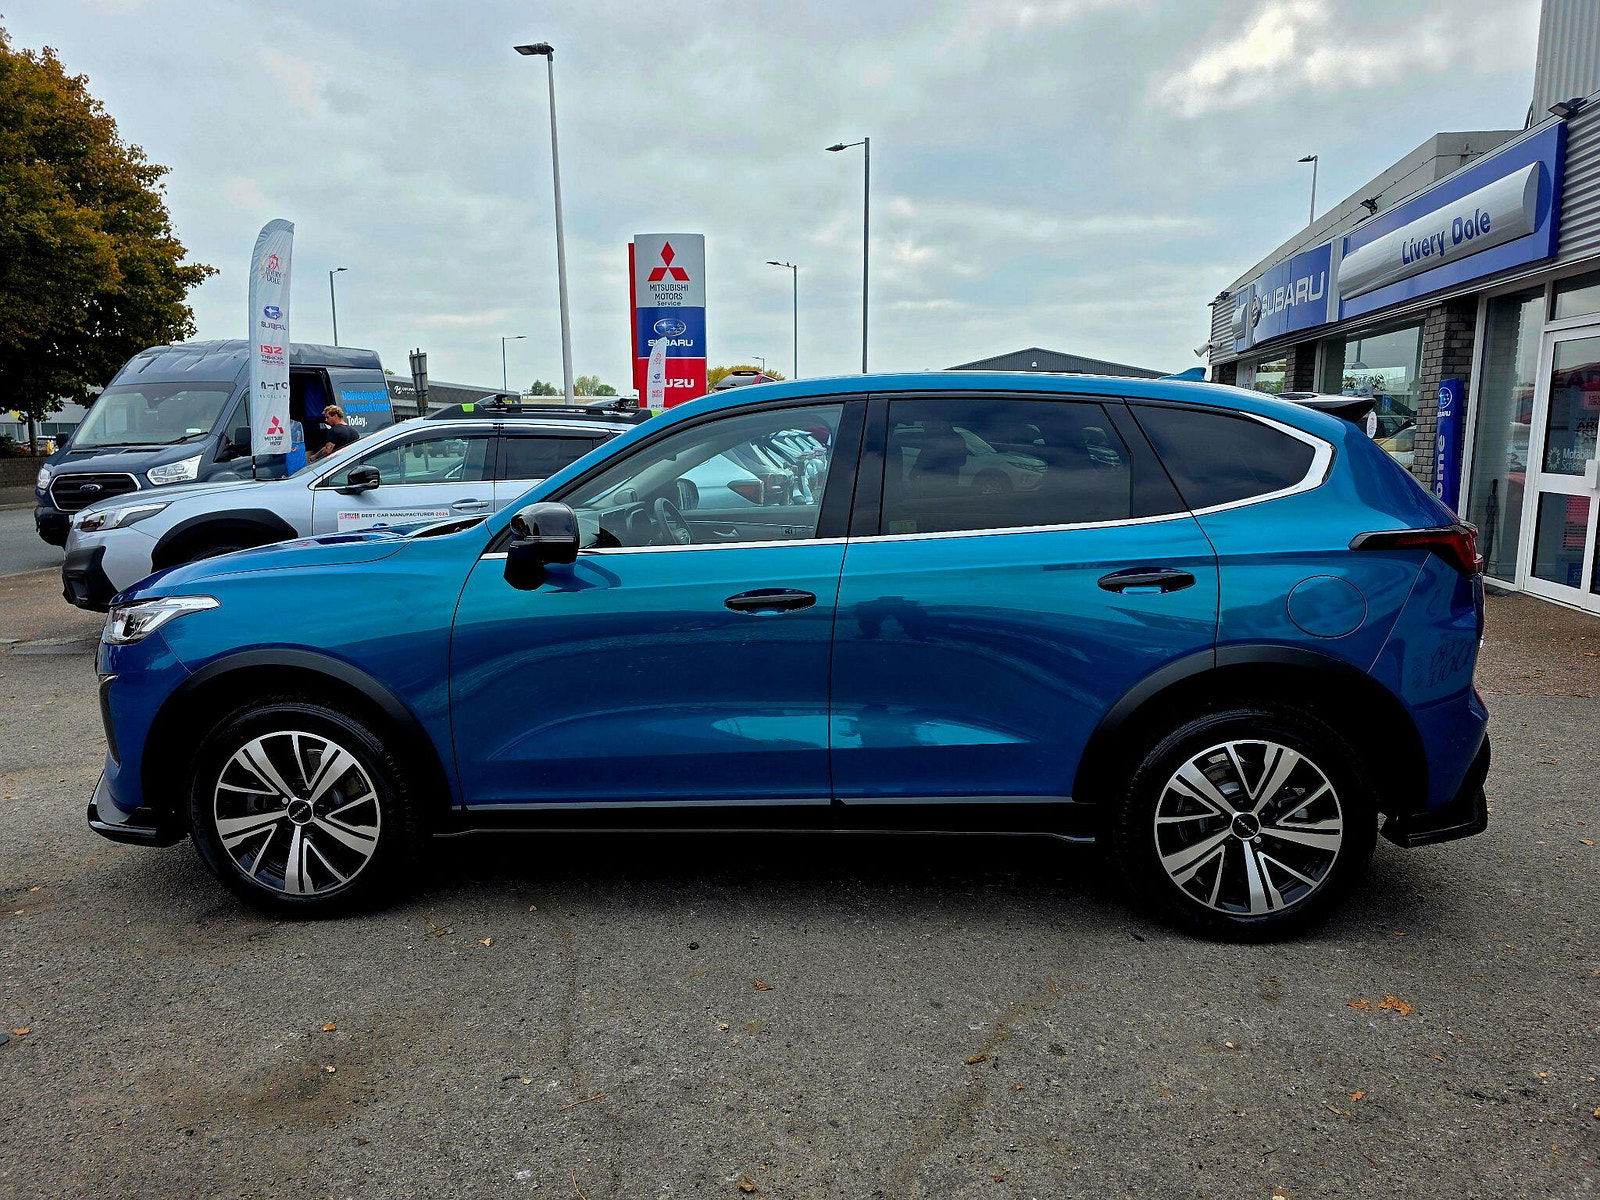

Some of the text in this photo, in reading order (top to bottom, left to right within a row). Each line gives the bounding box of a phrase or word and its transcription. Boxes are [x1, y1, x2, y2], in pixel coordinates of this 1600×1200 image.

[1402, 208, 1490, 265] Livery Dole
[654, 292, 683, 300] MOTORS
[1261, 271, 1325, 319] SUBARU
[647, 339, 694, 347] SARU
[346, 415, 368, 427] Today.
